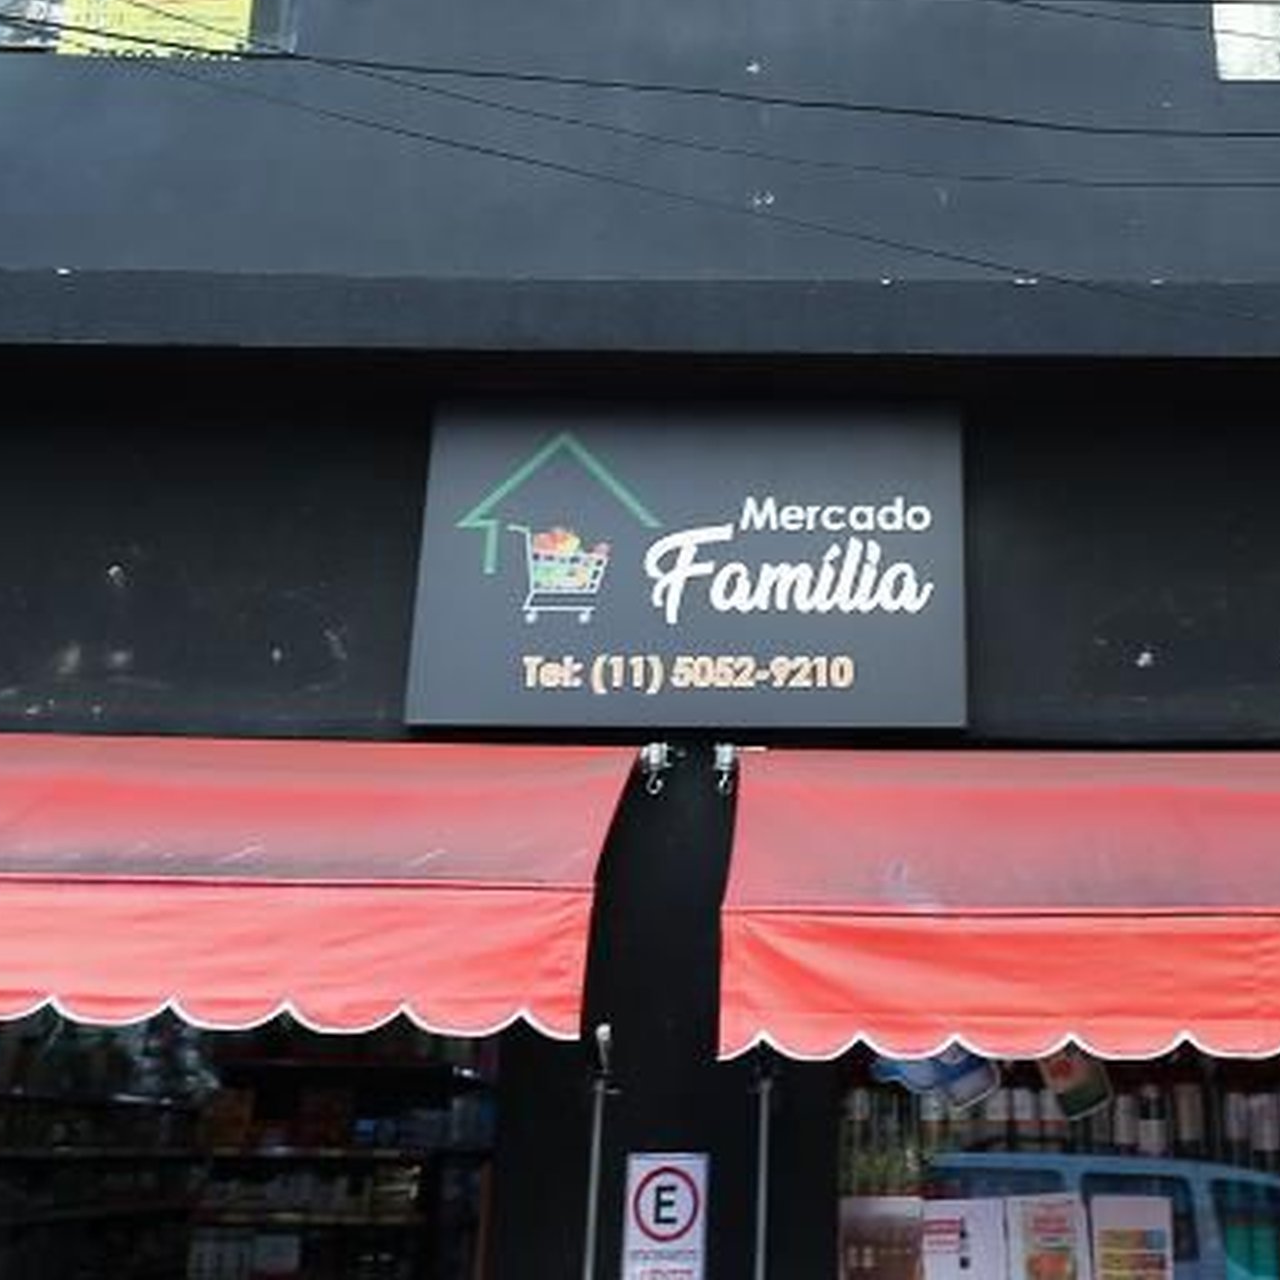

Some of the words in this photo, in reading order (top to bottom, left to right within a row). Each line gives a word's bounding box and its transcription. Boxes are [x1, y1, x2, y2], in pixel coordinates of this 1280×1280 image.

[739, 495, 932, 532] Mercado
[643, 523, 934, 625] Família
[590, 654, 665, 694] (11)
[670, 656, 855, 689] 5052-9210
[653, 1184, 679, 1225] E
